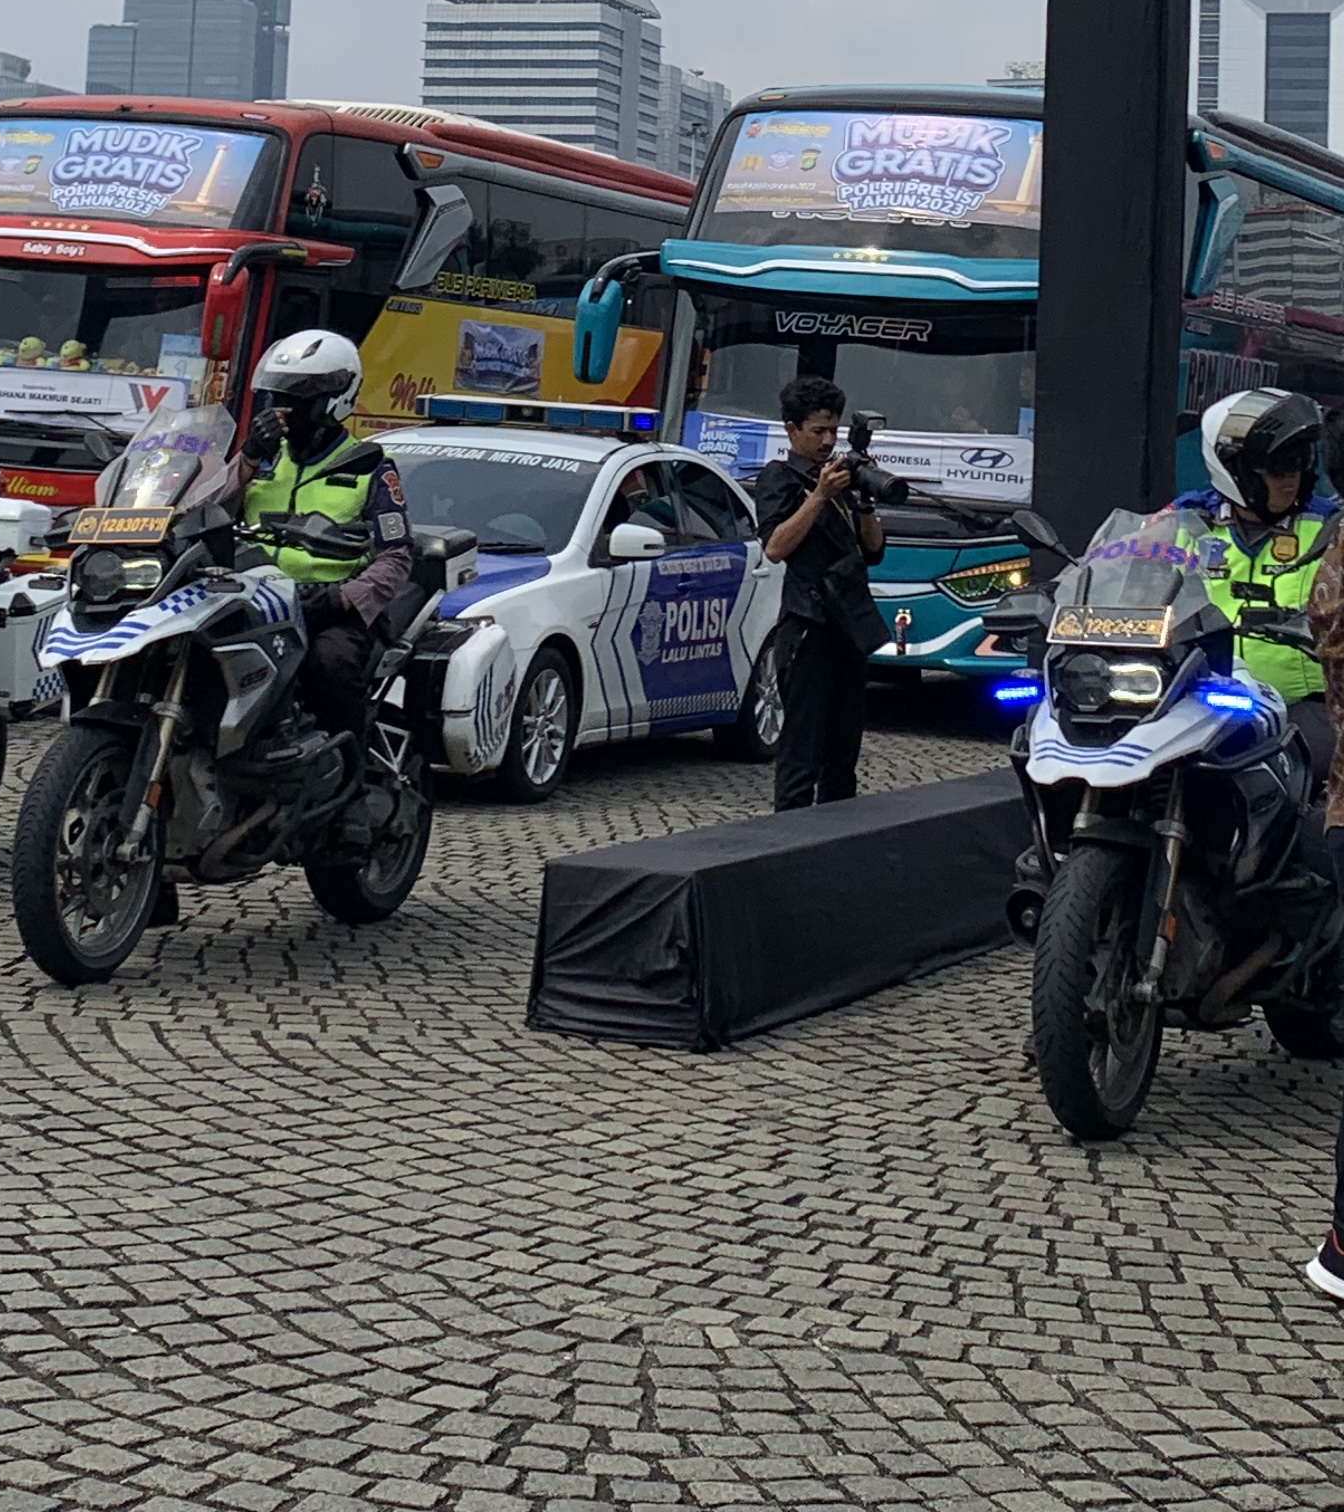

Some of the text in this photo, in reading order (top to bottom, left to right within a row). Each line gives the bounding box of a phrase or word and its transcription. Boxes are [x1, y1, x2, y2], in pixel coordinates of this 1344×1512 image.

[68, 126, 201, 163] MUDIK
[850, 118, 1011, 157] MUDIK
[52, 155, 192, 192] GRATIS
[835, 149, 1004, 189] GRATIS
[52, 183, 103, 200] POLRI
[106, 184, 168, 207] PRESISI
[61, 195, 153, 214] TAHUN 2023
[841, 181, 983, 208] POLRI PRESISI
[850, 194, 966, 216] TAHUN 2023
[22, 241, 52, 255] Baby
[436, 271, 537, 304] BUS PARIWISATA
[775, 310, 933, 342] VOYAGER
[29, 392, 68, 403] MAKMUR
[70, 394, 102, 406] SEJATI
[128, 434, 210, 458] POLISI
[697, 440, 739, 454] GRATIS
[699, 431, 740, 442] MUDIK
[438, 446, 485, 460] POLDA
[487, 450, 542, 467] METRO
[541, 457, 581, 473] JAYA
[946, 468, 1024, 485] HYUNDAI
[378, 511, 407, 542] B
[1081, 538, 1200, 569] POLISI
[664, 598, 727, 643] POLISI
[661, 642, 723, 663] LALU LINTAS
